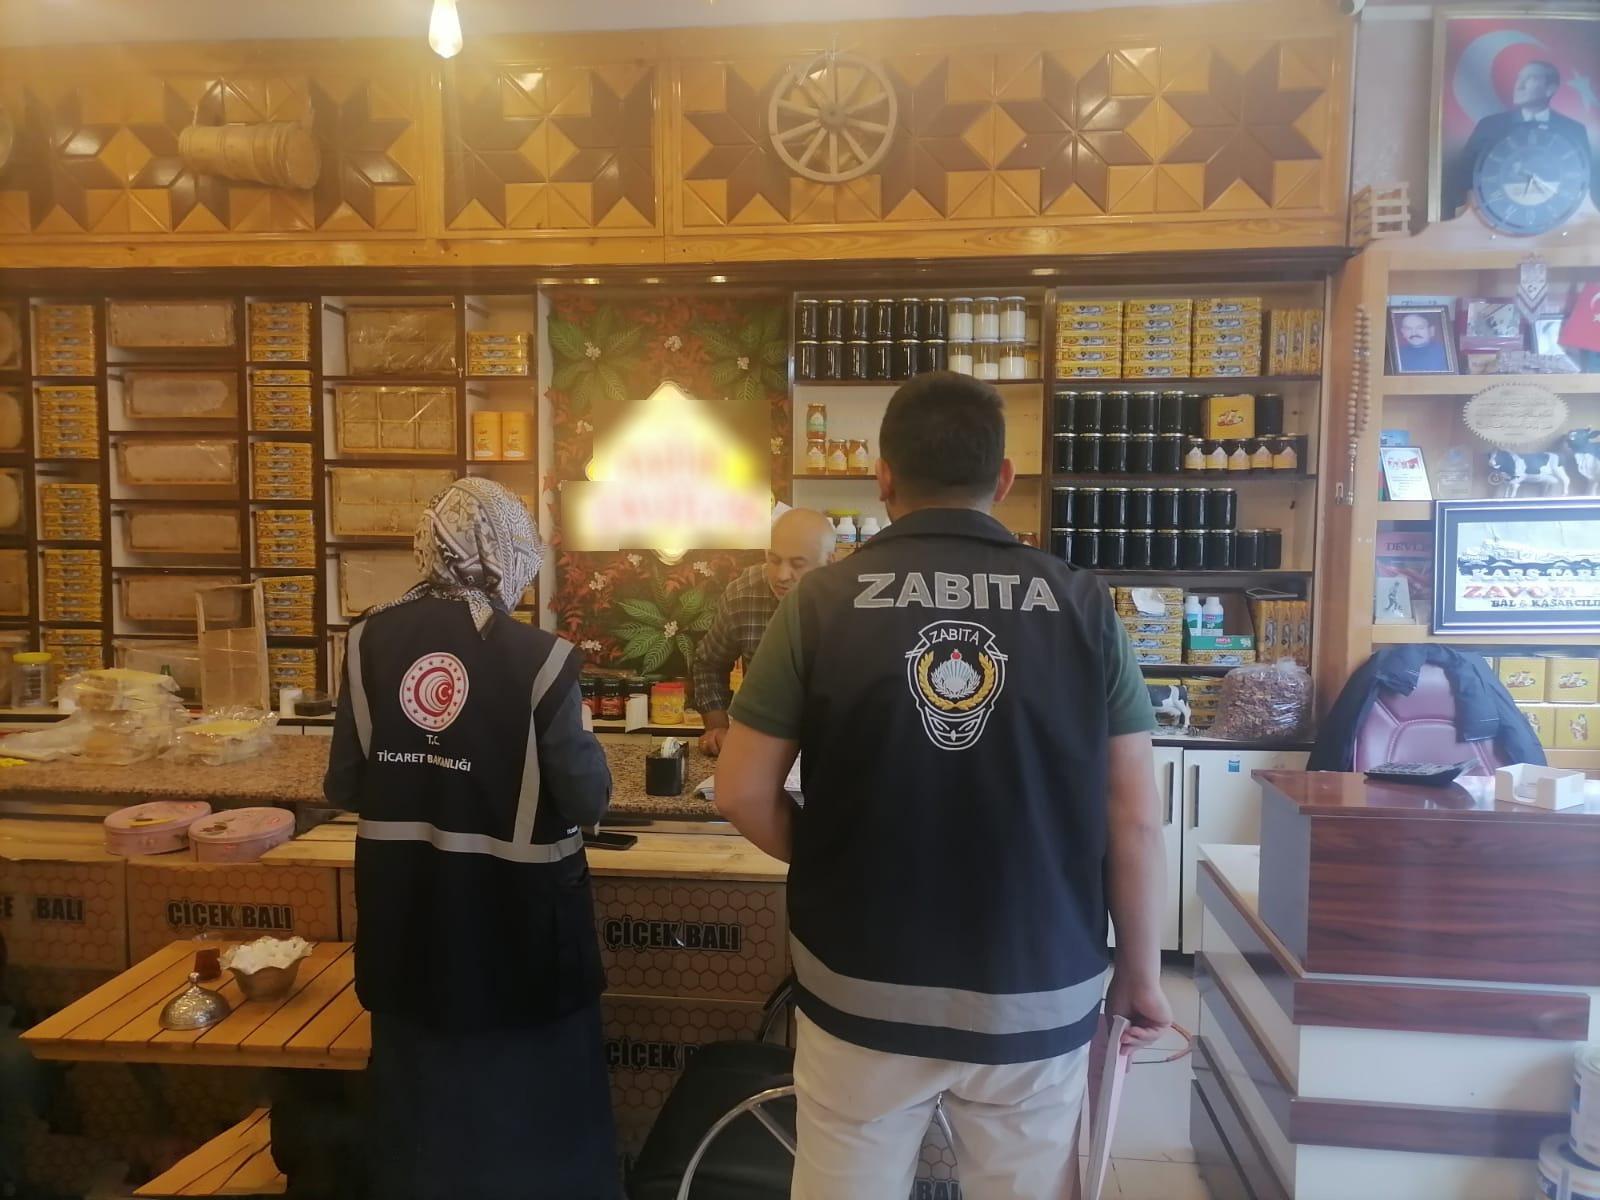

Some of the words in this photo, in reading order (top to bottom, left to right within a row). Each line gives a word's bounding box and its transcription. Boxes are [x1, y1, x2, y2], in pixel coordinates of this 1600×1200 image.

[854, 571, 1060, 612] ZABITA
[1491, 599, 1517, 607] BAL
[929, 627, 980, 646] ZABITA
[377, 749, 426, 763] TİCARET
[426, 754, 472, 772] BAKANLIĞI
[36, 896, 83, 920] BALI
[167, 898, 235, 931] ÇİÇEK
[240, 904, 293, 929] BALI
[604, 917, 681, 951] ÇİÇEK
[684, 923, 741, 951] BALI
